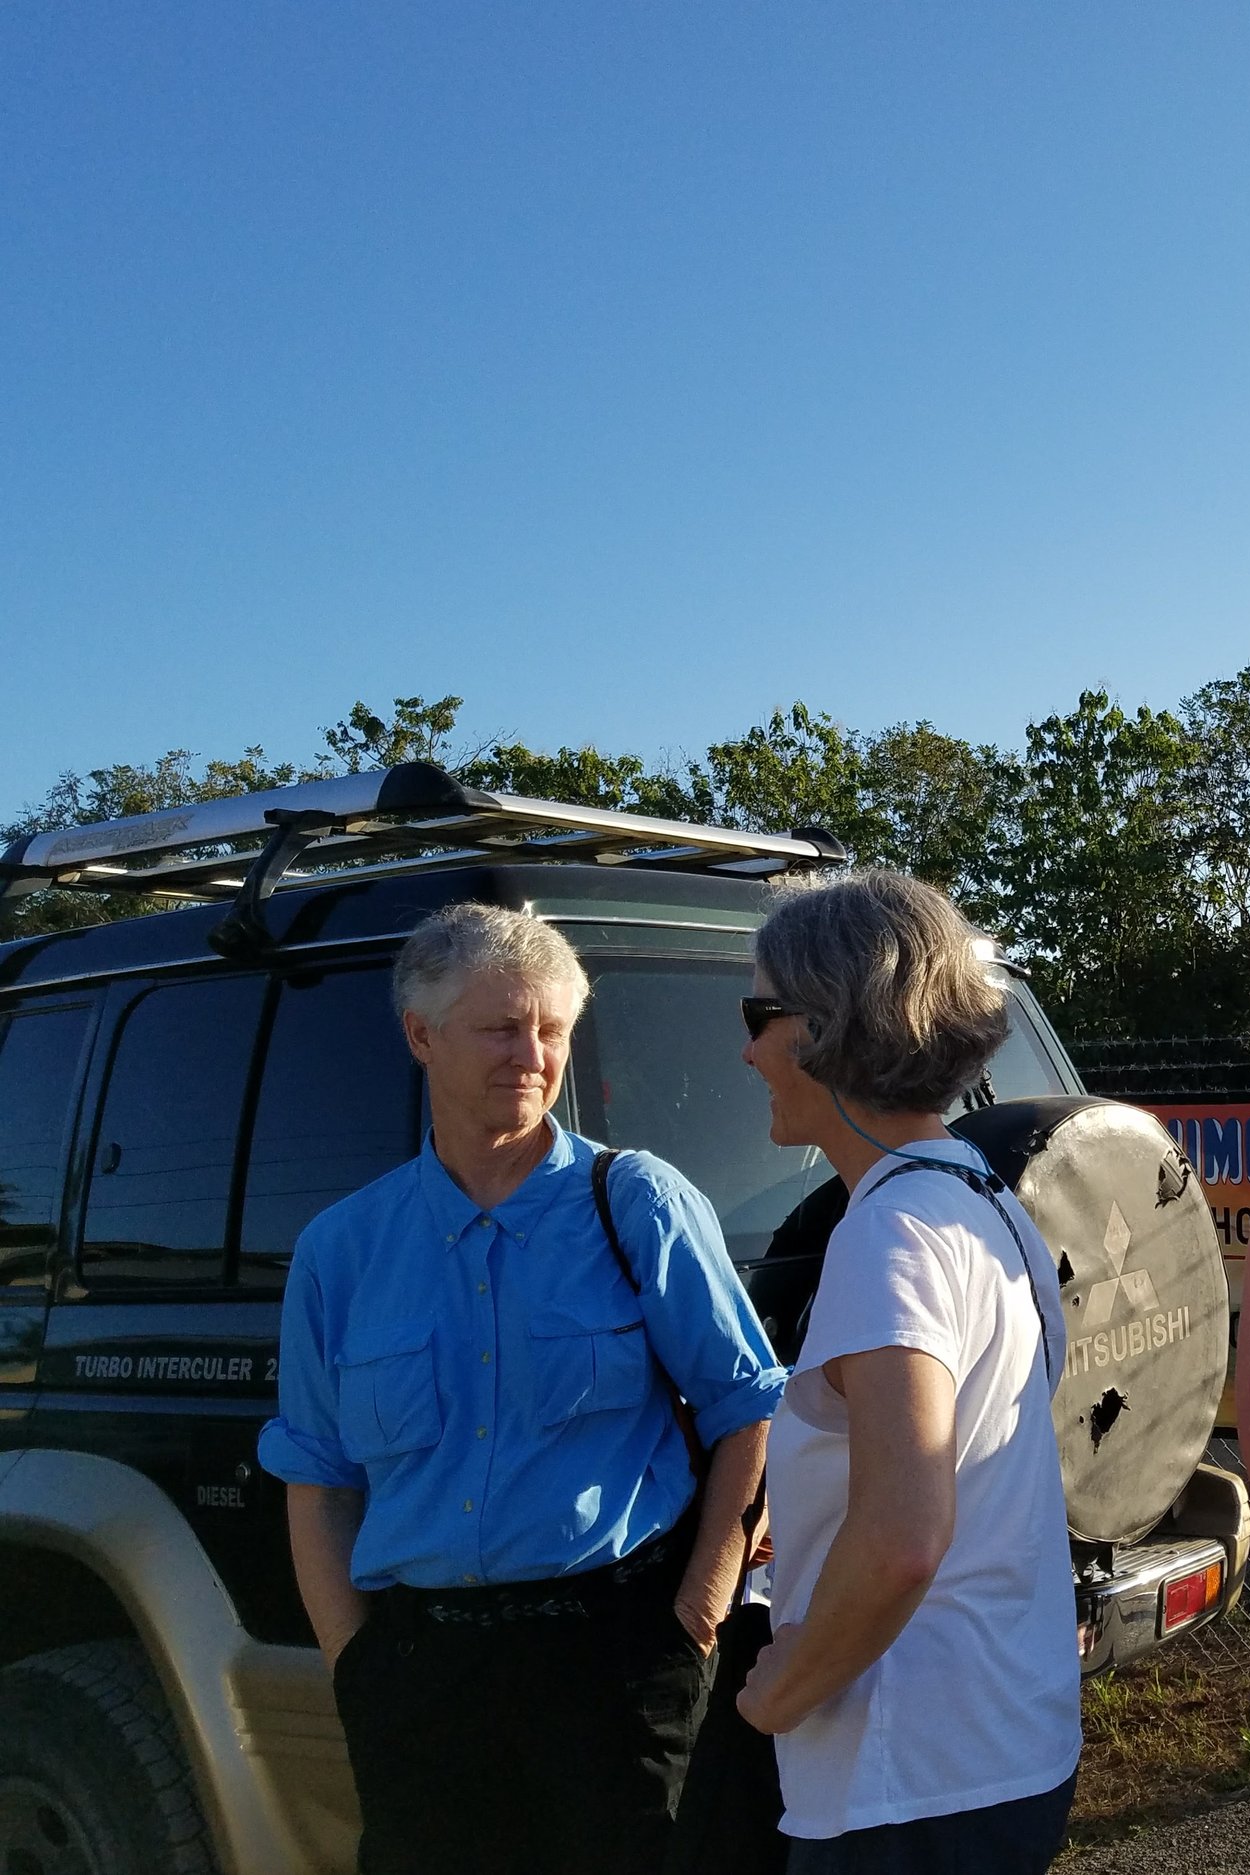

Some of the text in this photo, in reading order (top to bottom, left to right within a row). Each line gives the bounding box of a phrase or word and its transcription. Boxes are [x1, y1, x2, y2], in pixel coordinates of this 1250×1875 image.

[1065, 1306, 1191, 1379] ITSUBISHI
[75, 1355, 133, 1378] TURBO
[137, 1357, 253, 1381] INTERCULER
[197, 1486, 245, 1508] DIESEL
